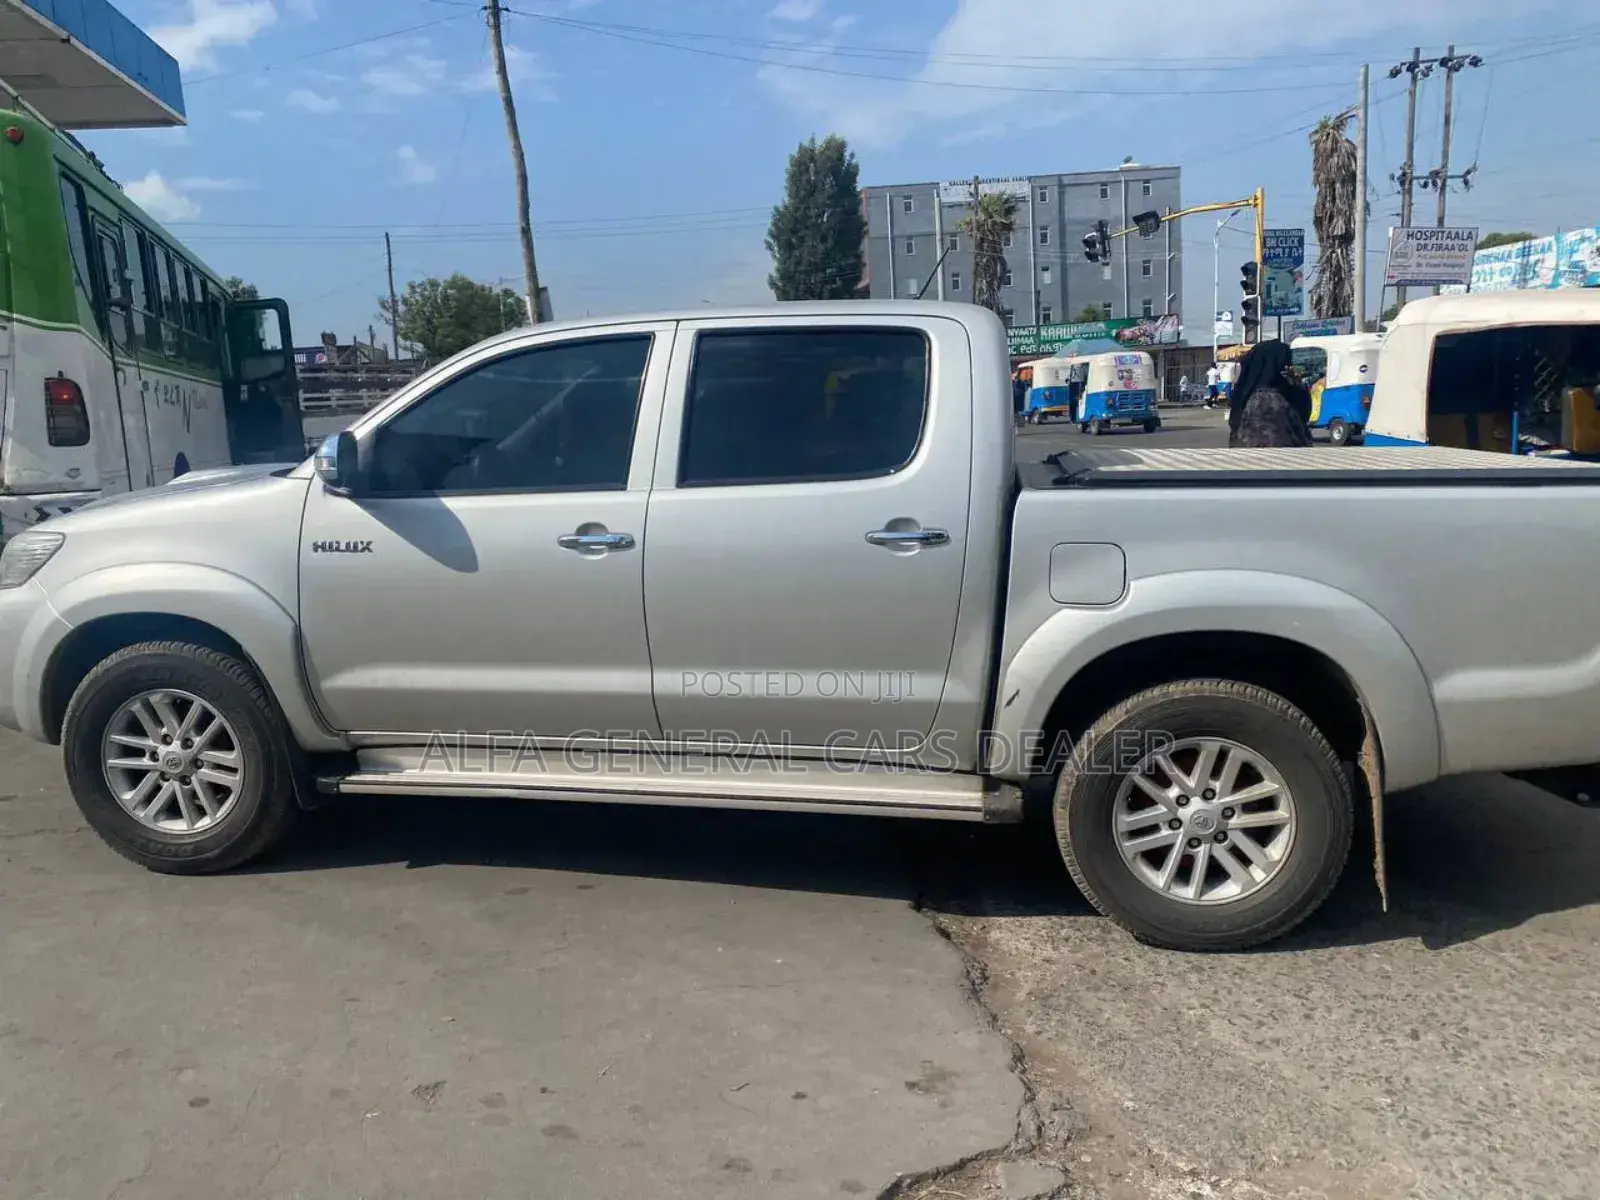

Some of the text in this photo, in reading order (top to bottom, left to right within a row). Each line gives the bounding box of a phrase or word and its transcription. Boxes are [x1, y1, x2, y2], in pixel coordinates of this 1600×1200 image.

[1406, 230, 1473, 241] HOSPITAALA
[1278, 236, 1299, 247] CLICK
[312, 540, 373, 553] HILUX
